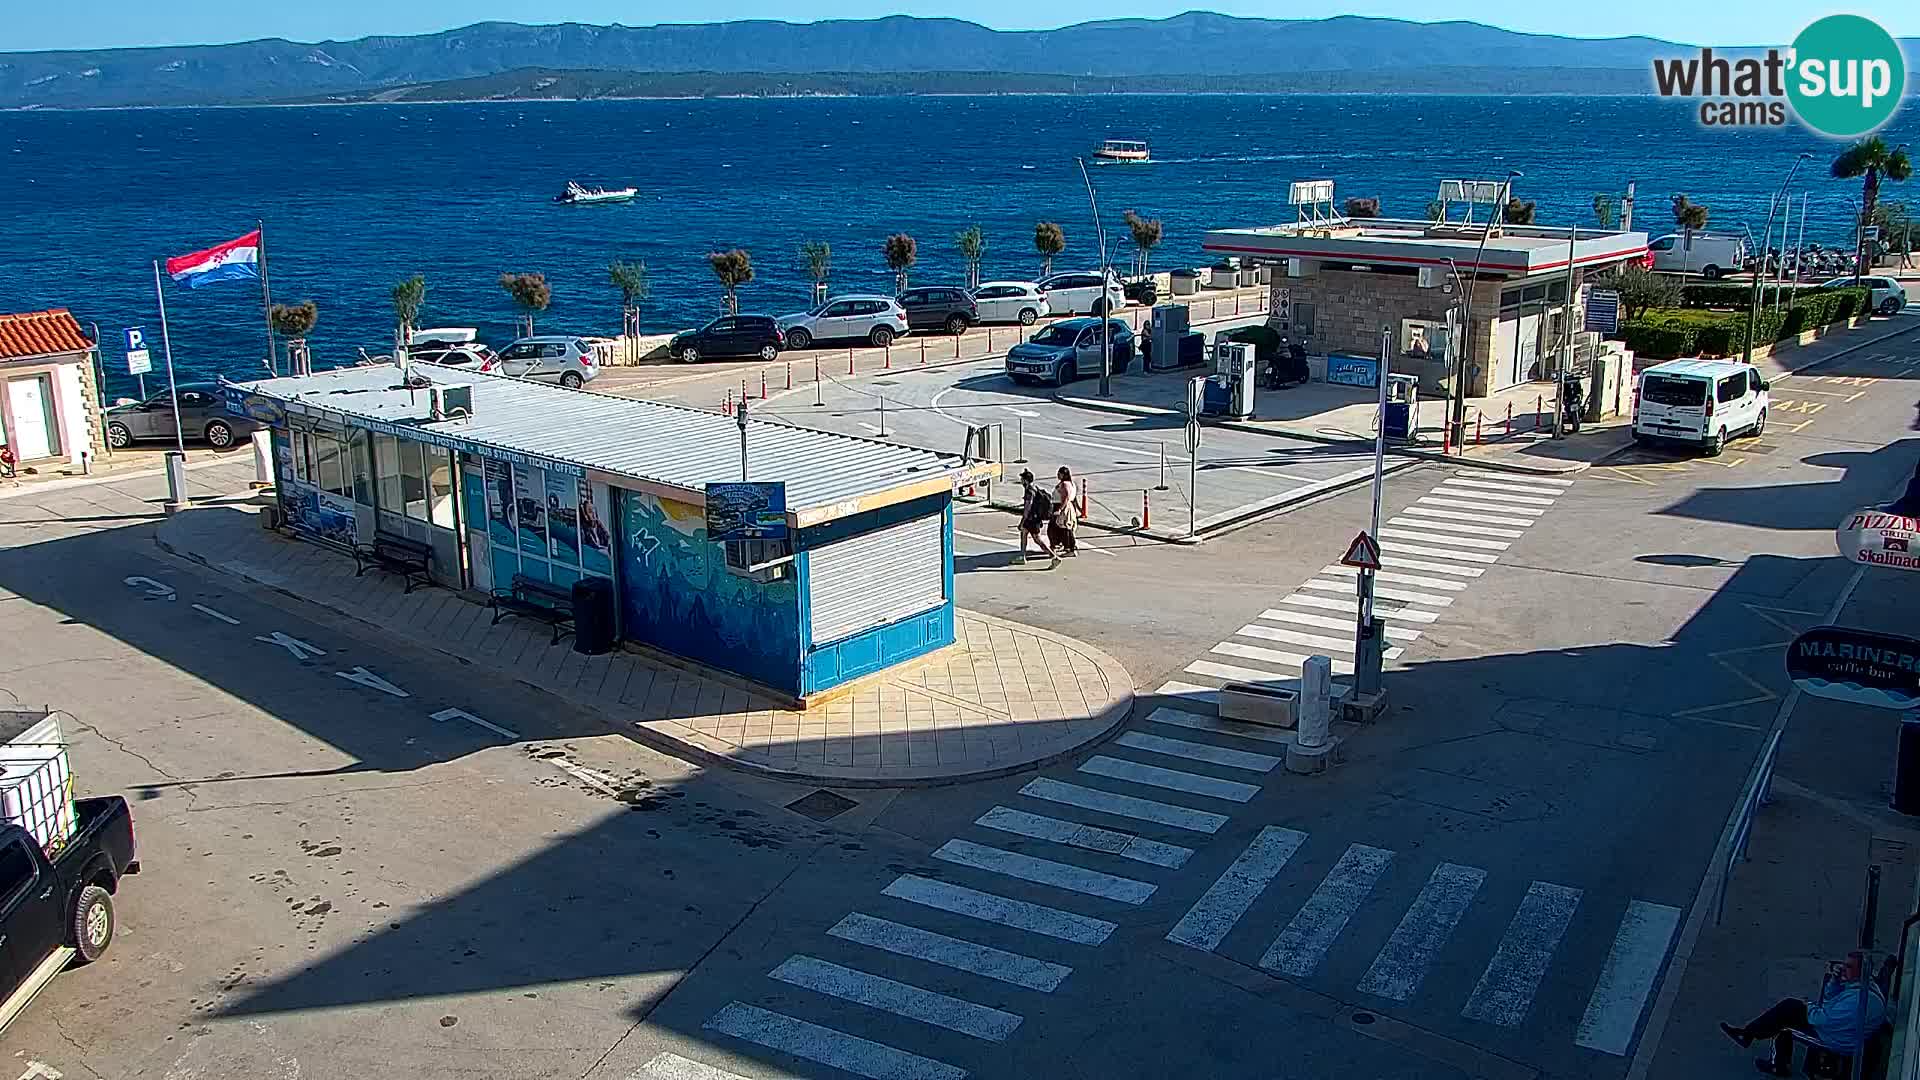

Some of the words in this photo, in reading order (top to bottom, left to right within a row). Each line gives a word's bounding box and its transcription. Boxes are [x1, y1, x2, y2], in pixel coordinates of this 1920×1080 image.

[128, 330, 142, 349] P
[1768, 399, 1828, 415] AXI
[478, 446, 492, 456] BUS
[494, 450, 526, 464] STATION
[528, 457, 554, 470] TICKET
[555, 463, 582, 477] OFFICE
[1880, 529, 1917, 540] GRILL
[1868, 665, 1897, 680] bar
